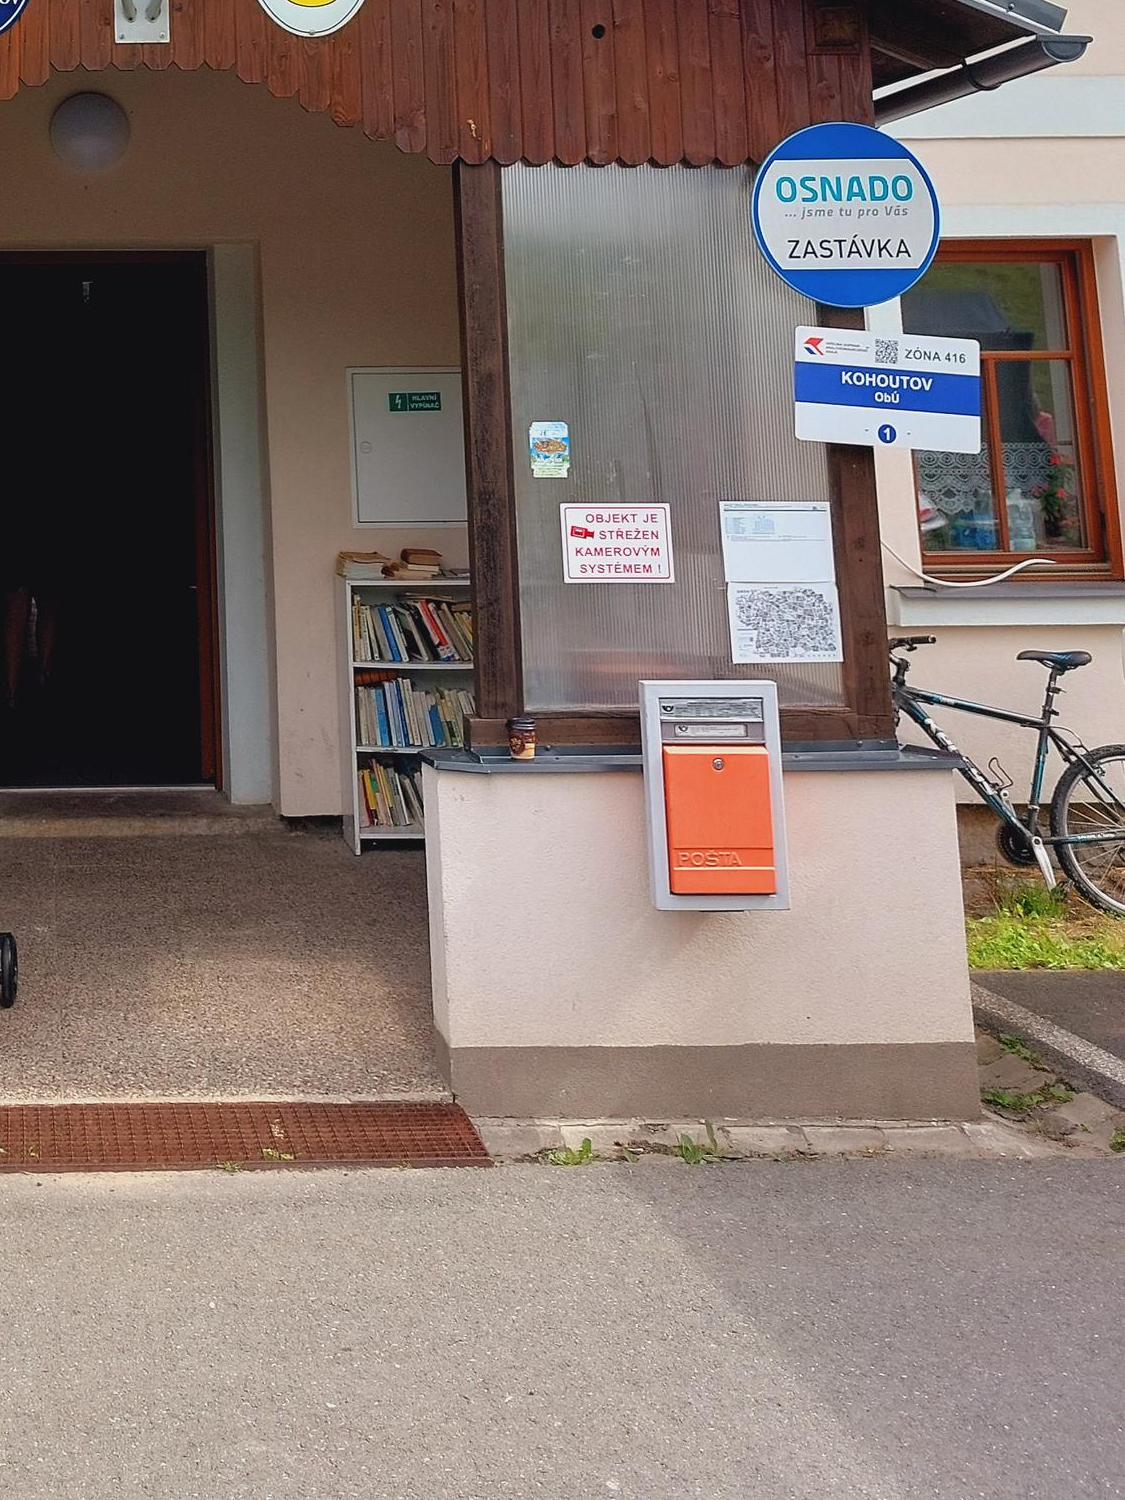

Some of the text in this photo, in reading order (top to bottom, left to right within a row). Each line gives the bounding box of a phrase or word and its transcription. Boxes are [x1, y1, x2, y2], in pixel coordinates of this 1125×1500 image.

[775, 175, 914, 203] OSNADO
[801, 205, 835, 220] jsme
[838, 206, 853, 218] tu
[857, 207, 880, 220] pro
[884, 204, 910, 218] Vás
[787, 234, 913, 260] ZASTÁVKA
[904, 346, 967, 364] ZÓNA 416
[840, 371, 934, 391] KOHOUTOV
[874, 391, 900, 404] ObÚ
[882, 427, 891, 441] 1
[585, 513, 659, 524] OBJEKT JE
[599, 526, 660, 541] STŘEŽEN
[575, 544, 661, 558] KAMEROVÝM
[579, 561, 653, 575] SYSTÉMEM
[678, 849, 743, 867] POŠTA
